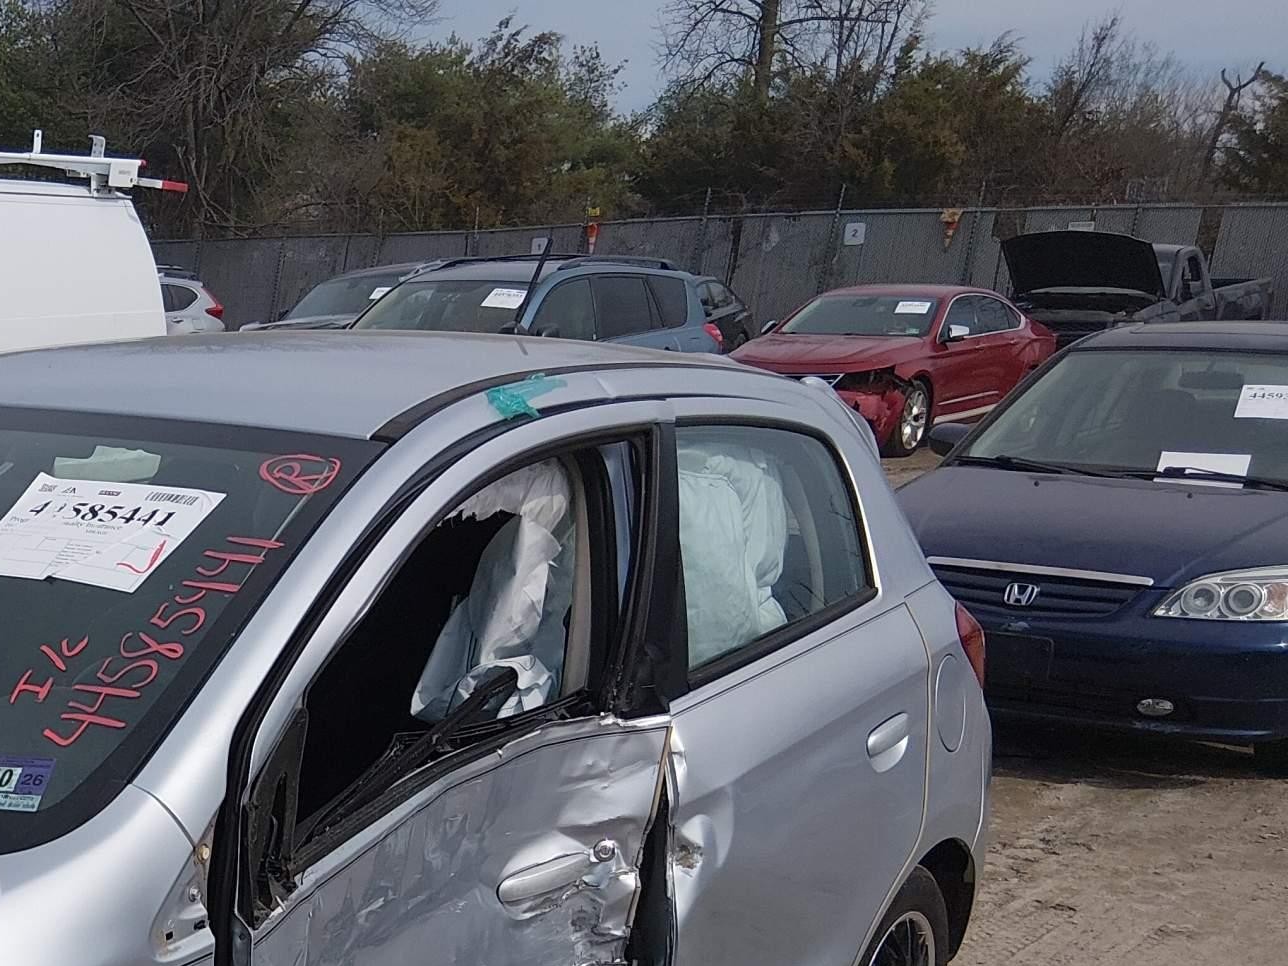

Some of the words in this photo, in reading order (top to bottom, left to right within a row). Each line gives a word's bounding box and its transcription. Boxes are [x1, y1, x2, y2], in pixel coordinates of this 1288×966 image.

[851, 228, 859, 238] 2
[43, 536, 286, 746] 44585441
[21, 773, 44, 786] 26
